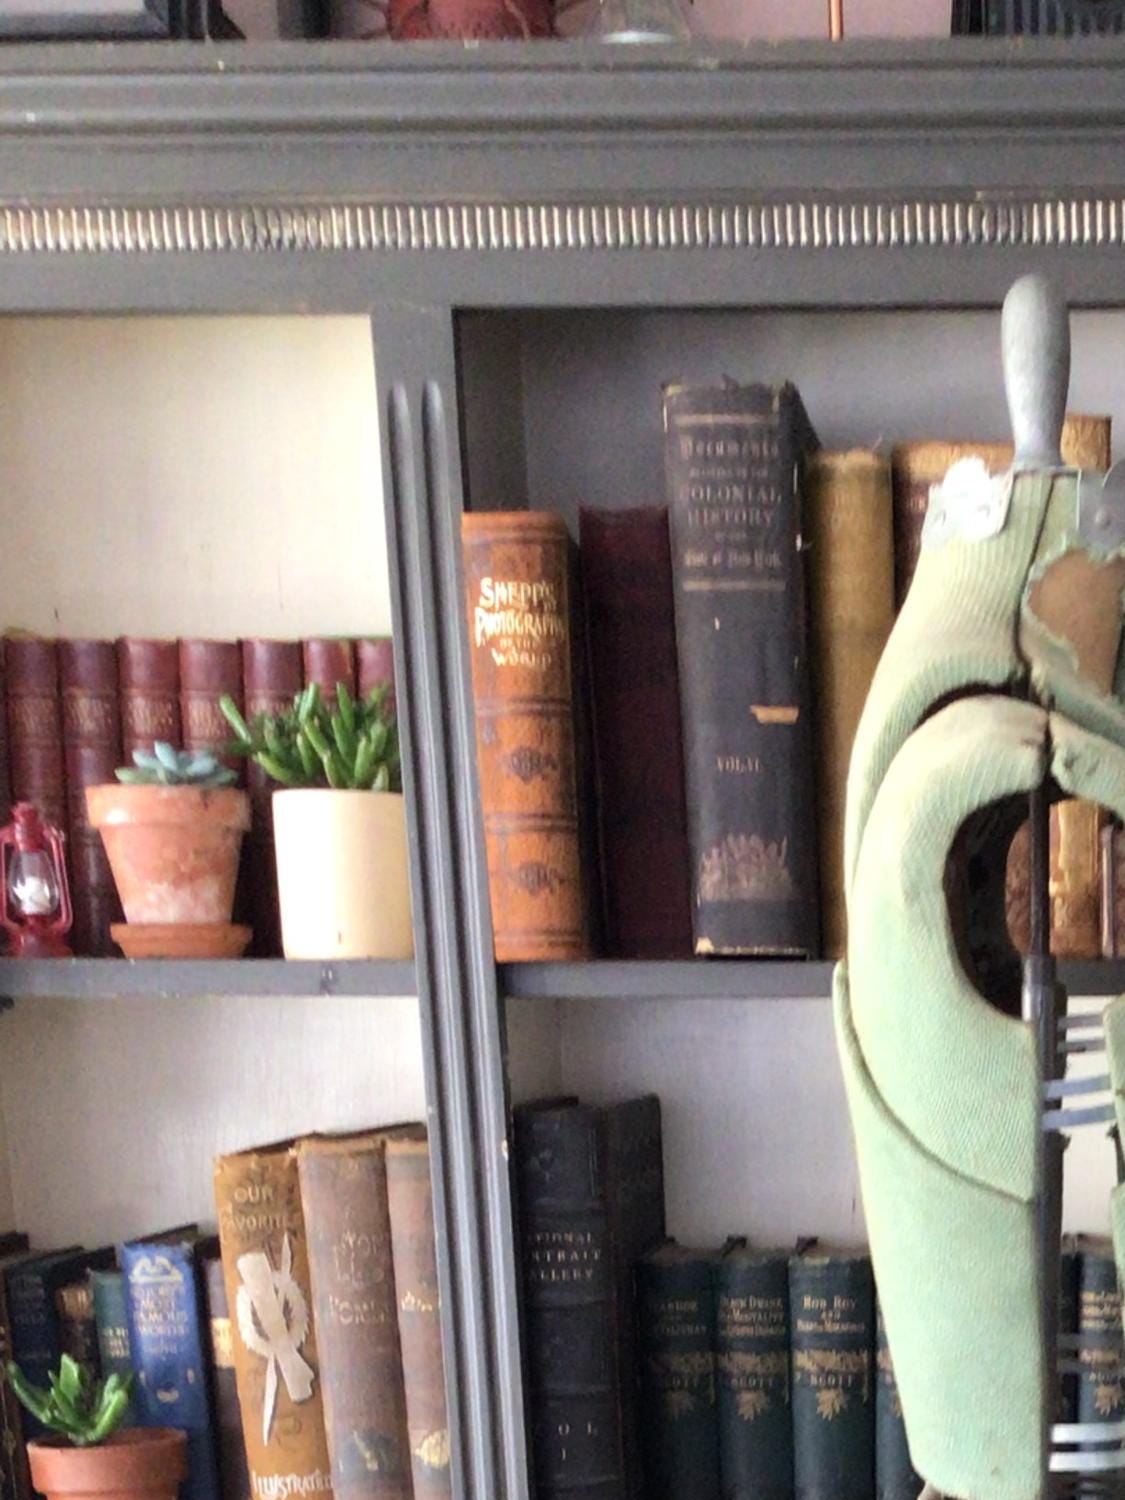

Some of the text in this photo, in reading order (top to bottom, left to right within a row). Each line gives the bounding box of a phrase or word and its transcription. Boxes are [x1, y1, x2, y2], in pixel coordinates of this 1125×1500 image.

[490, 647, 553, 671] WORLD
[233, 1185, 276, 1204] OUR
[526, 1231, 594, 1245] ATIONAL
[531, 1267, 594, 1282] ALLERY
[803, 1294, 859, 1310] ROB ROY
[810, 1373, 854, 1388] SCOTT
